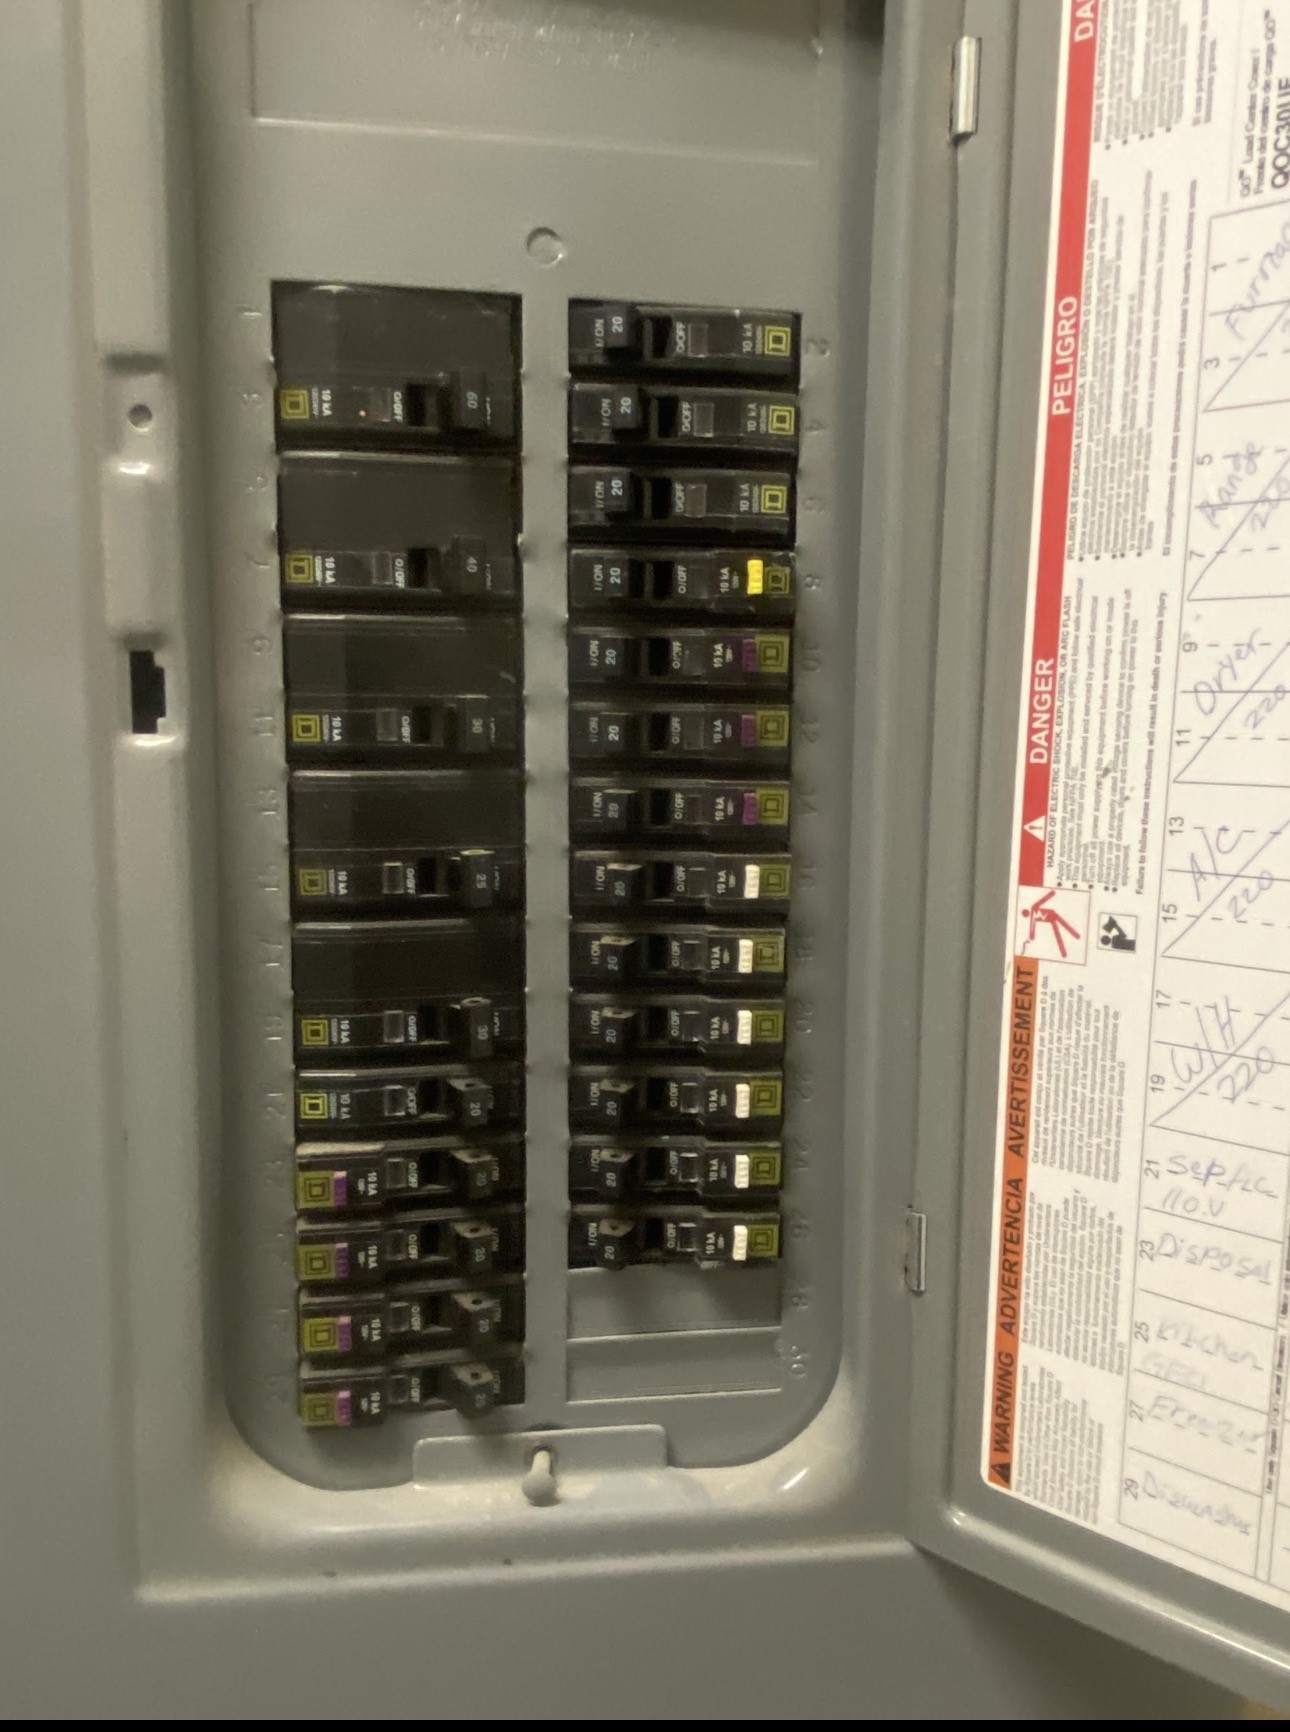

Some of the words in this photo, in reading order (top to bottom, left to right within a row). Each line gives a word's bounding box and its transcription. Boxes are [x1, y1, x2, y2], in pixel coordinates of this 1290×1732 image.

[1074, 0, 1096, 42] DA
[613, 316, 623, 332] 20
[743, 323, 753, 337] kA
[742, 340, 752, 352] 10
[1051, 295, 1079, 416] PELIGRO
[1203, 356, 1221, 370] 3
[467, 391, 478, 409] 60
[621, 397, 631, 414] 20
[747, 403, 757, 417] kA
[747, 421, 757, 432] 10
[1196, 453, 1213, 466] 5
[612, 480, 622, 495] 20
[740, 483, 751, 497] kA
[740, 501, 750, 512] 10
[1188, 549, 1205, 560] 7
[467, 557, 478, 572] 40
[610, 568, 621, 583] 20
[719, 567, 730, 579] kA
[719, 581, 730, 592] 10
[1063, 596, 1073, 627] FLASH
[713, 644, 724, 655] kA
[1181, 641, 1199, 653] 9
[605, 649, 617, 665] 20
[713, 657, 723, 668] 10
[1029, 657, 1055, 764] DANGER
[473, 719, 483, 733] 30
[712, 720, 723, 731] kA
[608, 726, 619, 740] 20
[712, 733, 722, 744] 10
[1175, 728, 1192, 747] 11
[1050, 768, 1061, 812] ELECTRIC
[715, 797, 726, 808] kA
[608, 803, 619, 818] 20
[715, 809, 725, 821] 10
[1049, 815, 1058, 828] OF
[1167, 816, 1185, 836] 13
[1046, 830, 1057, 868] HAZARD
[476, 873, 487, 888] 25
[717, 871, 727, 882] kA
[615, 881, 625, 896] 20
[717, 883, 727, 894] 10
[1161, 903, 1178, 924] 15
[711, 946, 722, 957] kA
[607, 956, 618, 971] 20
[711, 959, 721, 970] 10
[1154, 989, 1172, 1009] 17
[710, 1017, 721, 1028] kA
[478, 1025, 488, 1040] 30
[606, 1029, 616, 1043] 20
[710, 1029, 720, 1039] 10
[1007, 965, 1034, 1158] AVERTISSEMENT
[1149, 1073, 1166, 1094] 19
[709, 1089, 719, 1101] kA
[471, 1102, 481, 1116] 20
[606, 1101, 617, 1116] 20
[709, 1102, 719, 1112] 10
[709, 1158, 719, 1170] kA
[1143, 1159, 1160, 1180] 21
[606, 1173, 616, 1187] 20
[709, 1172, 719, 1182] 10
[706, 1231, 716, 1242] kA
[605, 1246, 615, 1260] 20
[706, 1243, 716, 1254] 10
[1138, 1239, 1154, 1262] 23
[999, 1177, 1023, 1337] ADVERTENCIA
[1133, 1320, 1150, 1344] 25
[993, 1351, 1015, 1454] WARNING
[1128, 1399, 1144, 1423] 27
[1123, 1477, 1139, 1501] 29
